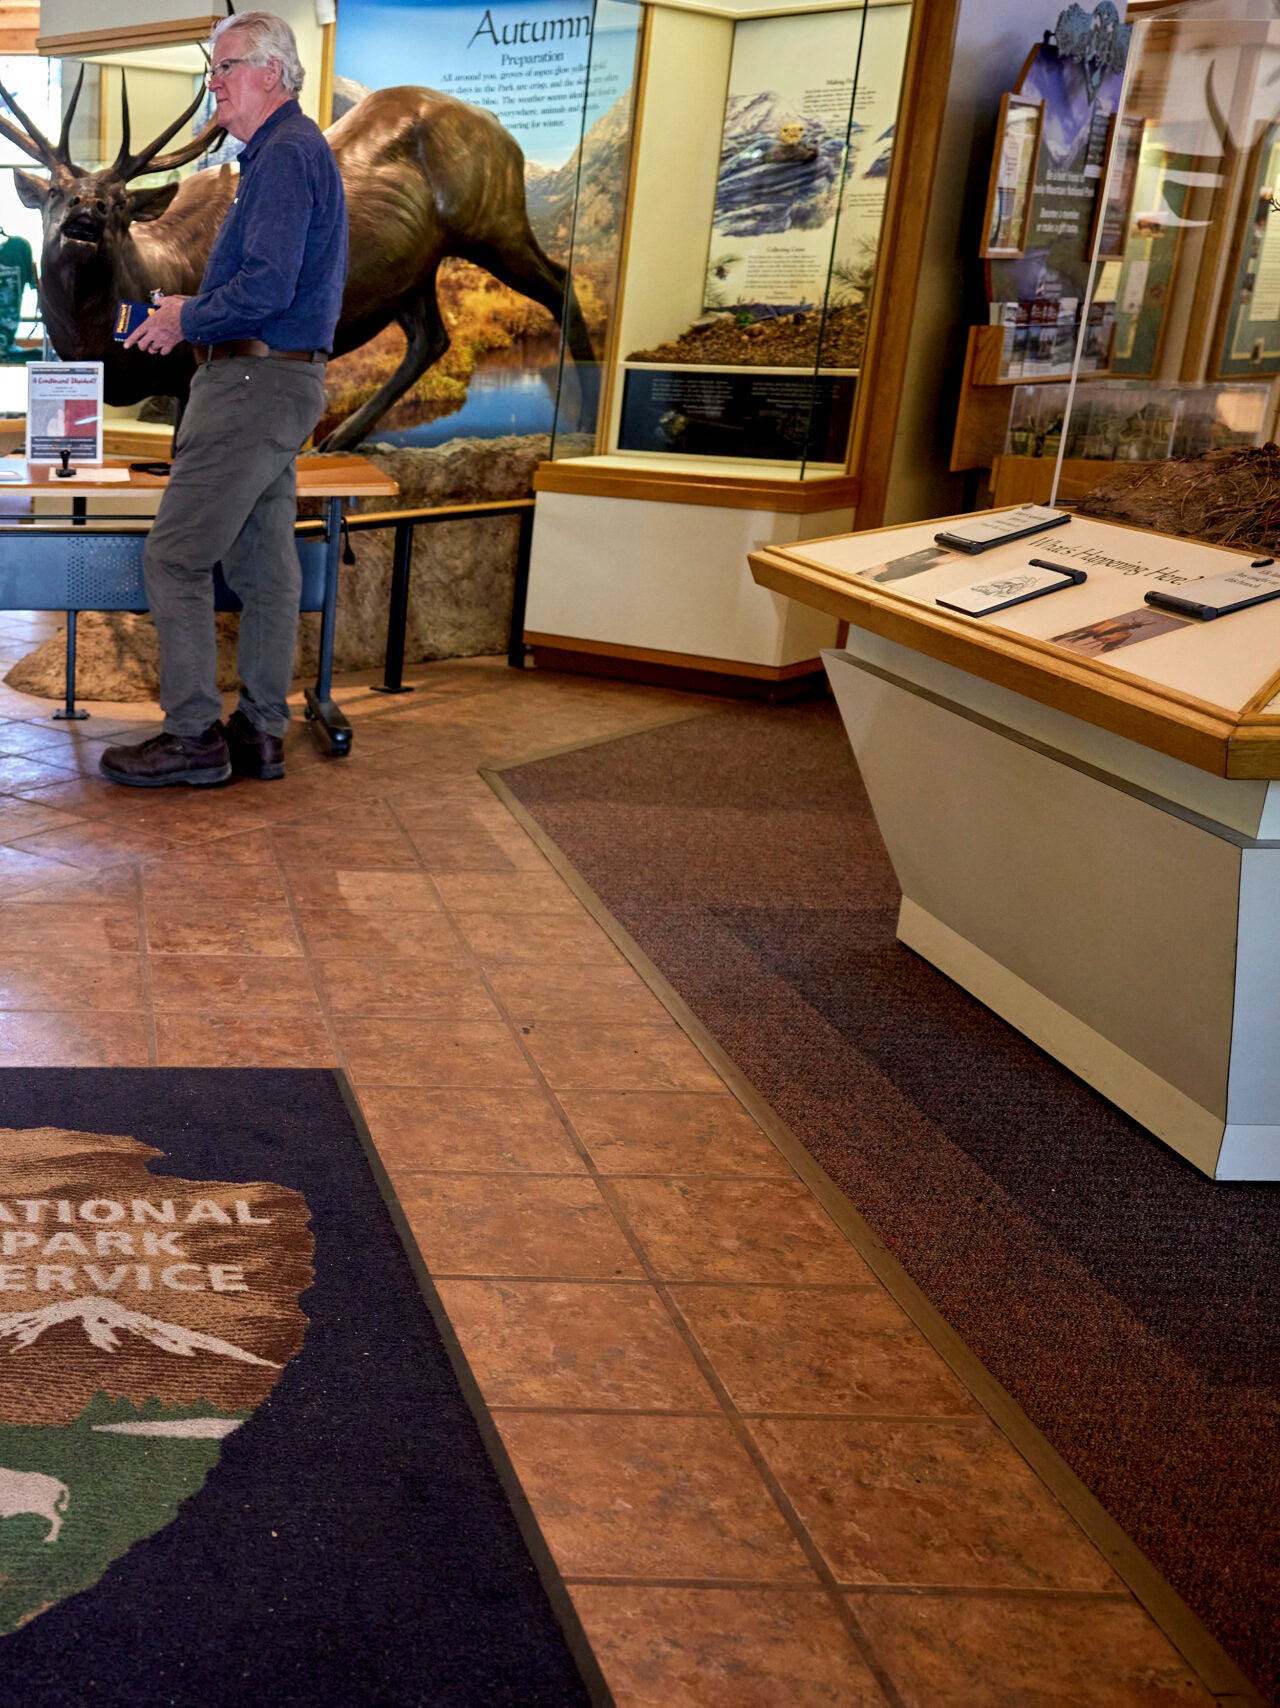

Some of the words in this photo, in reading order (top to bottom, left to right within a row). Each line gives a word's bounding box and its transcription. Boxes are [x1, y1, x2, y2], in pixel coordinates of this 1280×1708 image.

[467, 9, 590, 48] Autumn
[501, 51, 564, 67] Preparation
[454, 73, 482, 81] around
[502, 95, 516, 104] The
[1028, 536, 1076, 560] What's
[1070, 548, 1150, 576] Happening
[1, 1230, 187, 1257] PARK
